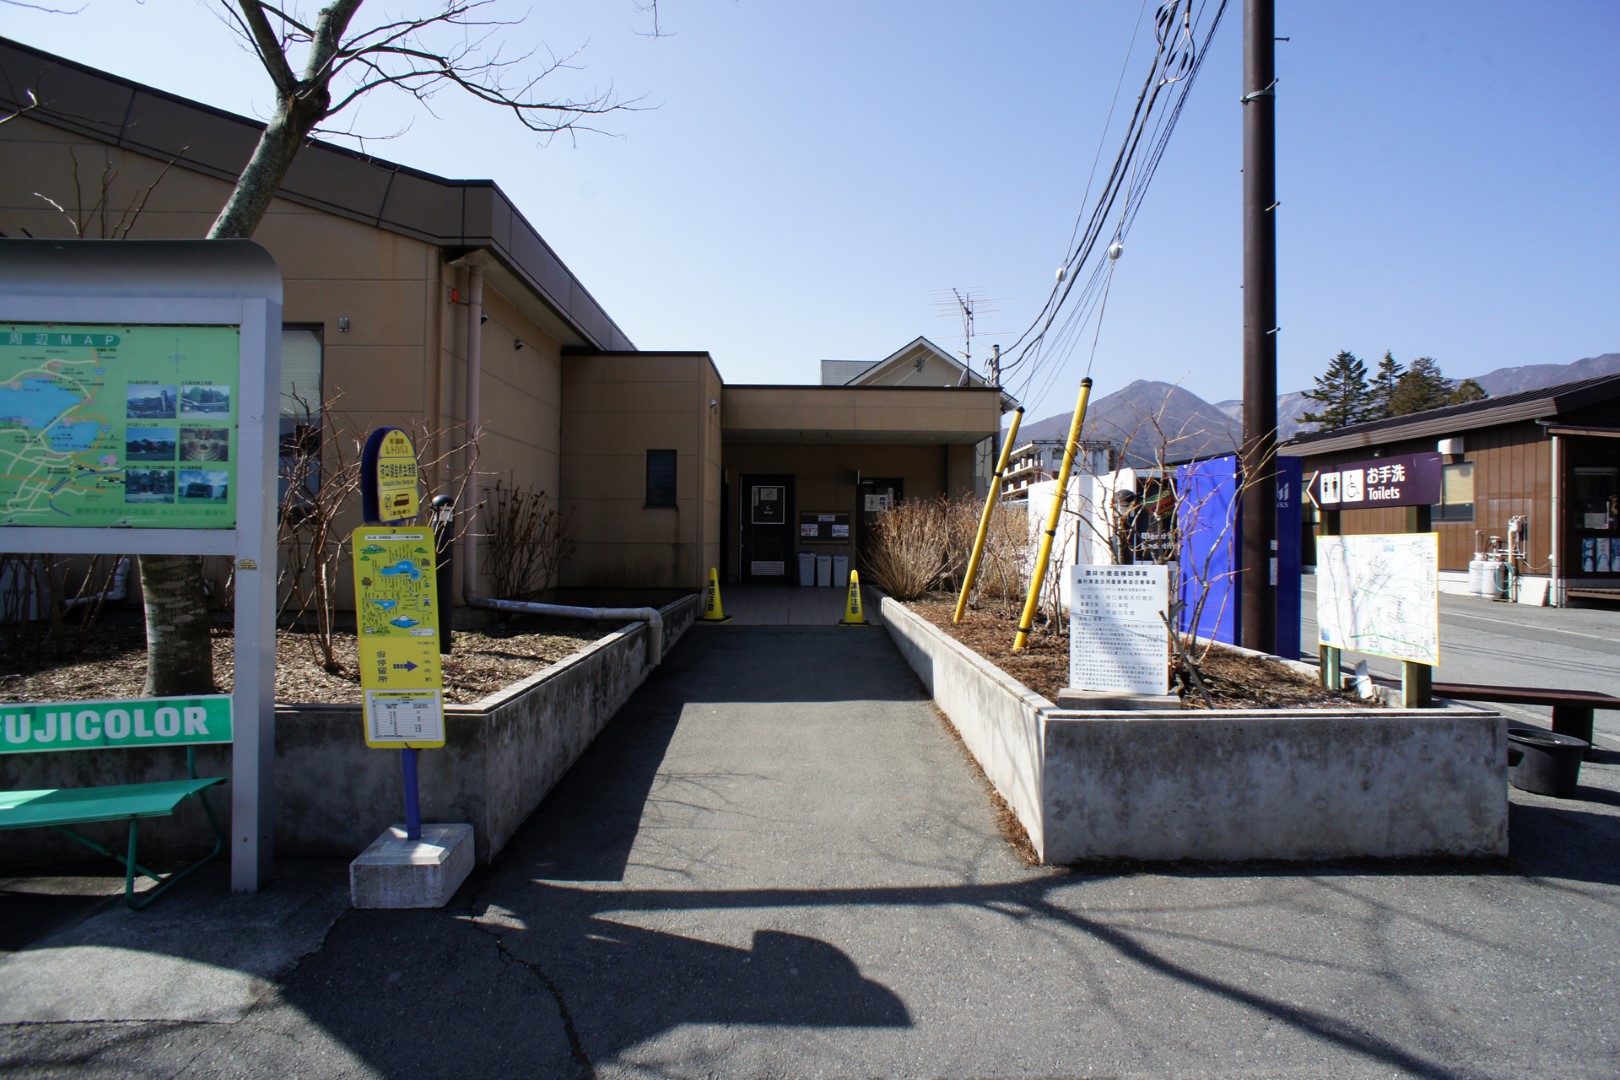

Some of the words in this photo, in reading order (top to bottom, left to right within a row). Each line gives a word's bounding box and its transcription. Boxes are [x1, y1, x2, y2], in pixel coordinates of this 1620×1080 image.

[1366, 463, 1406, 484] お手洗
[1366, 485, 1401, 501] Toilets
[376, 650, 389, 683] 当停留所
[0, 706, 210, 744] UJICOLOR
